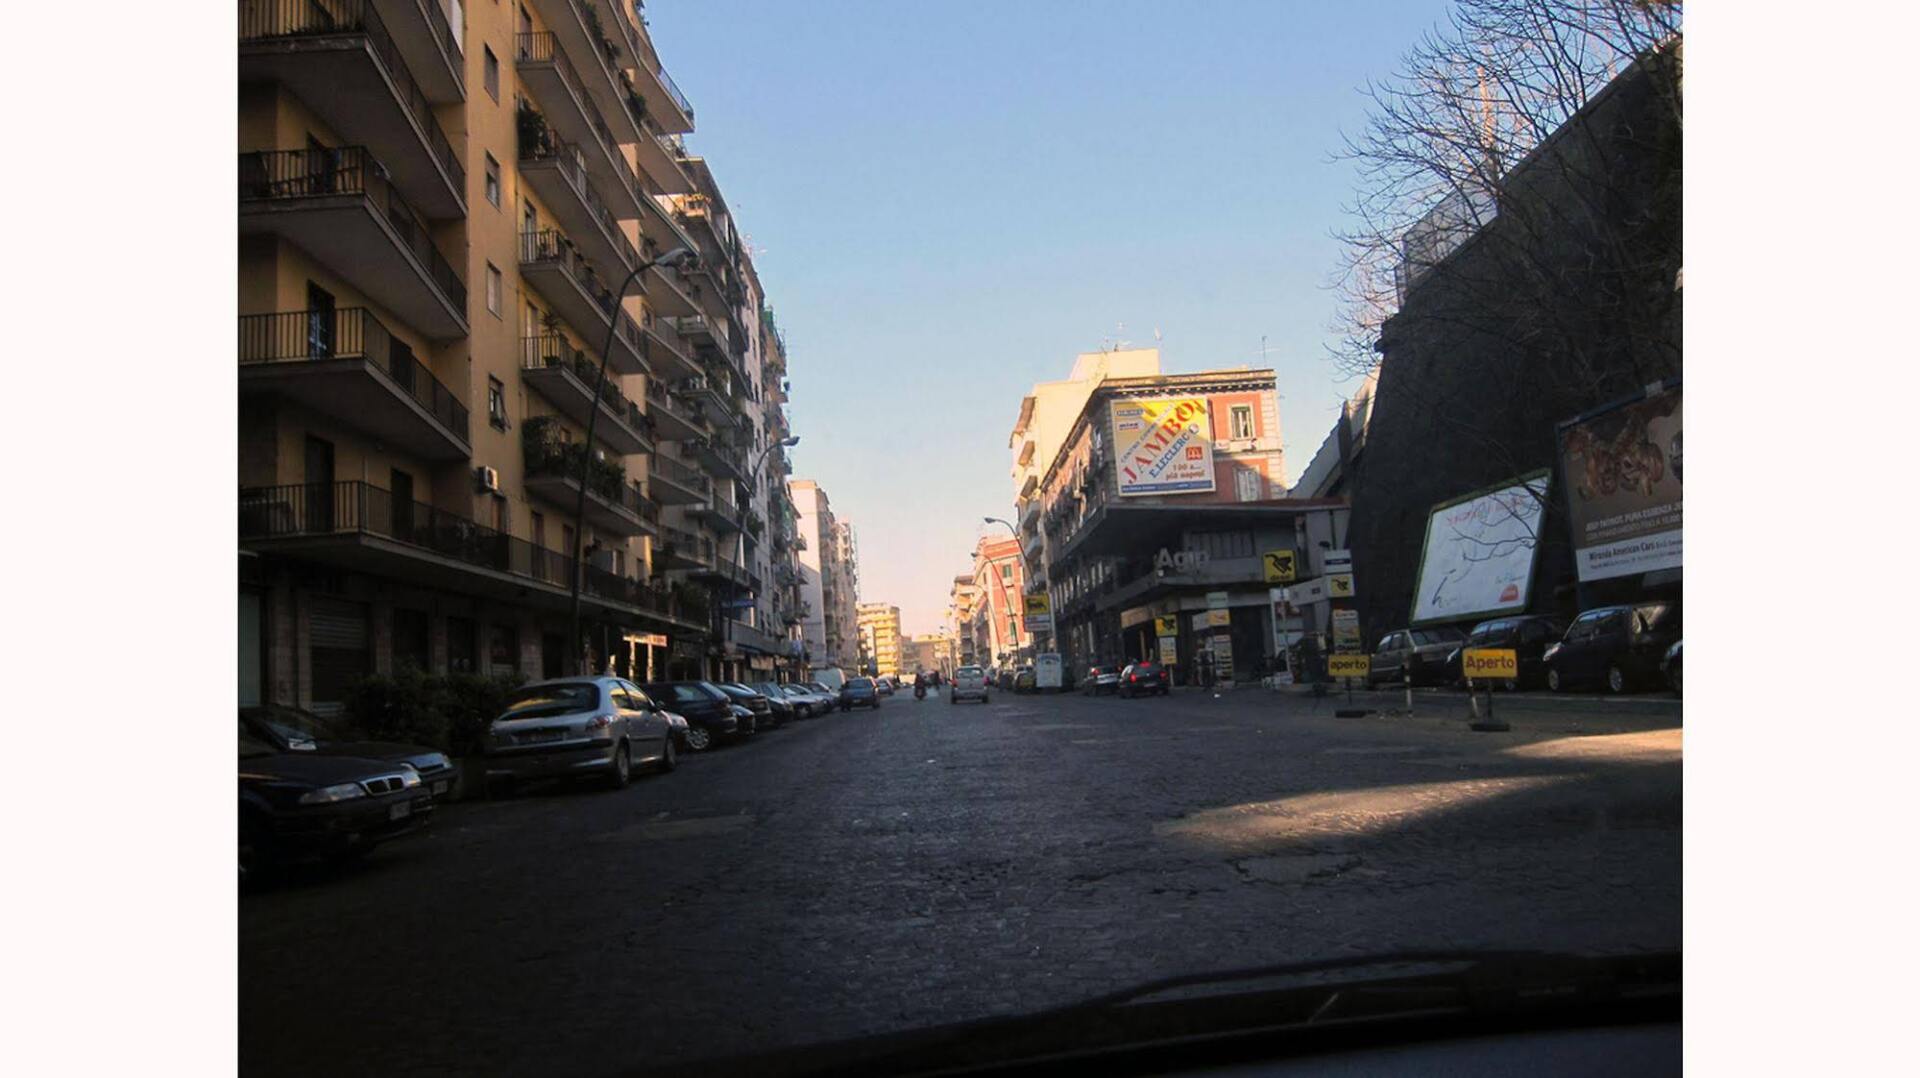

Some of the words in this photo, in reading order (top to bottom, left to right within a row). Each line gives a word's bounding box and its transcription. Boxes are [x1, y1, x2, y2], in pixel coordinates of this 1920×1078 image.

[1123, 402, 1195, 484] JAMBO
[1158, 548, 1211, 572] Agip
[1330, 658, 1367, 673] aperto
[1466, 655, 1515, 672] Aperto
